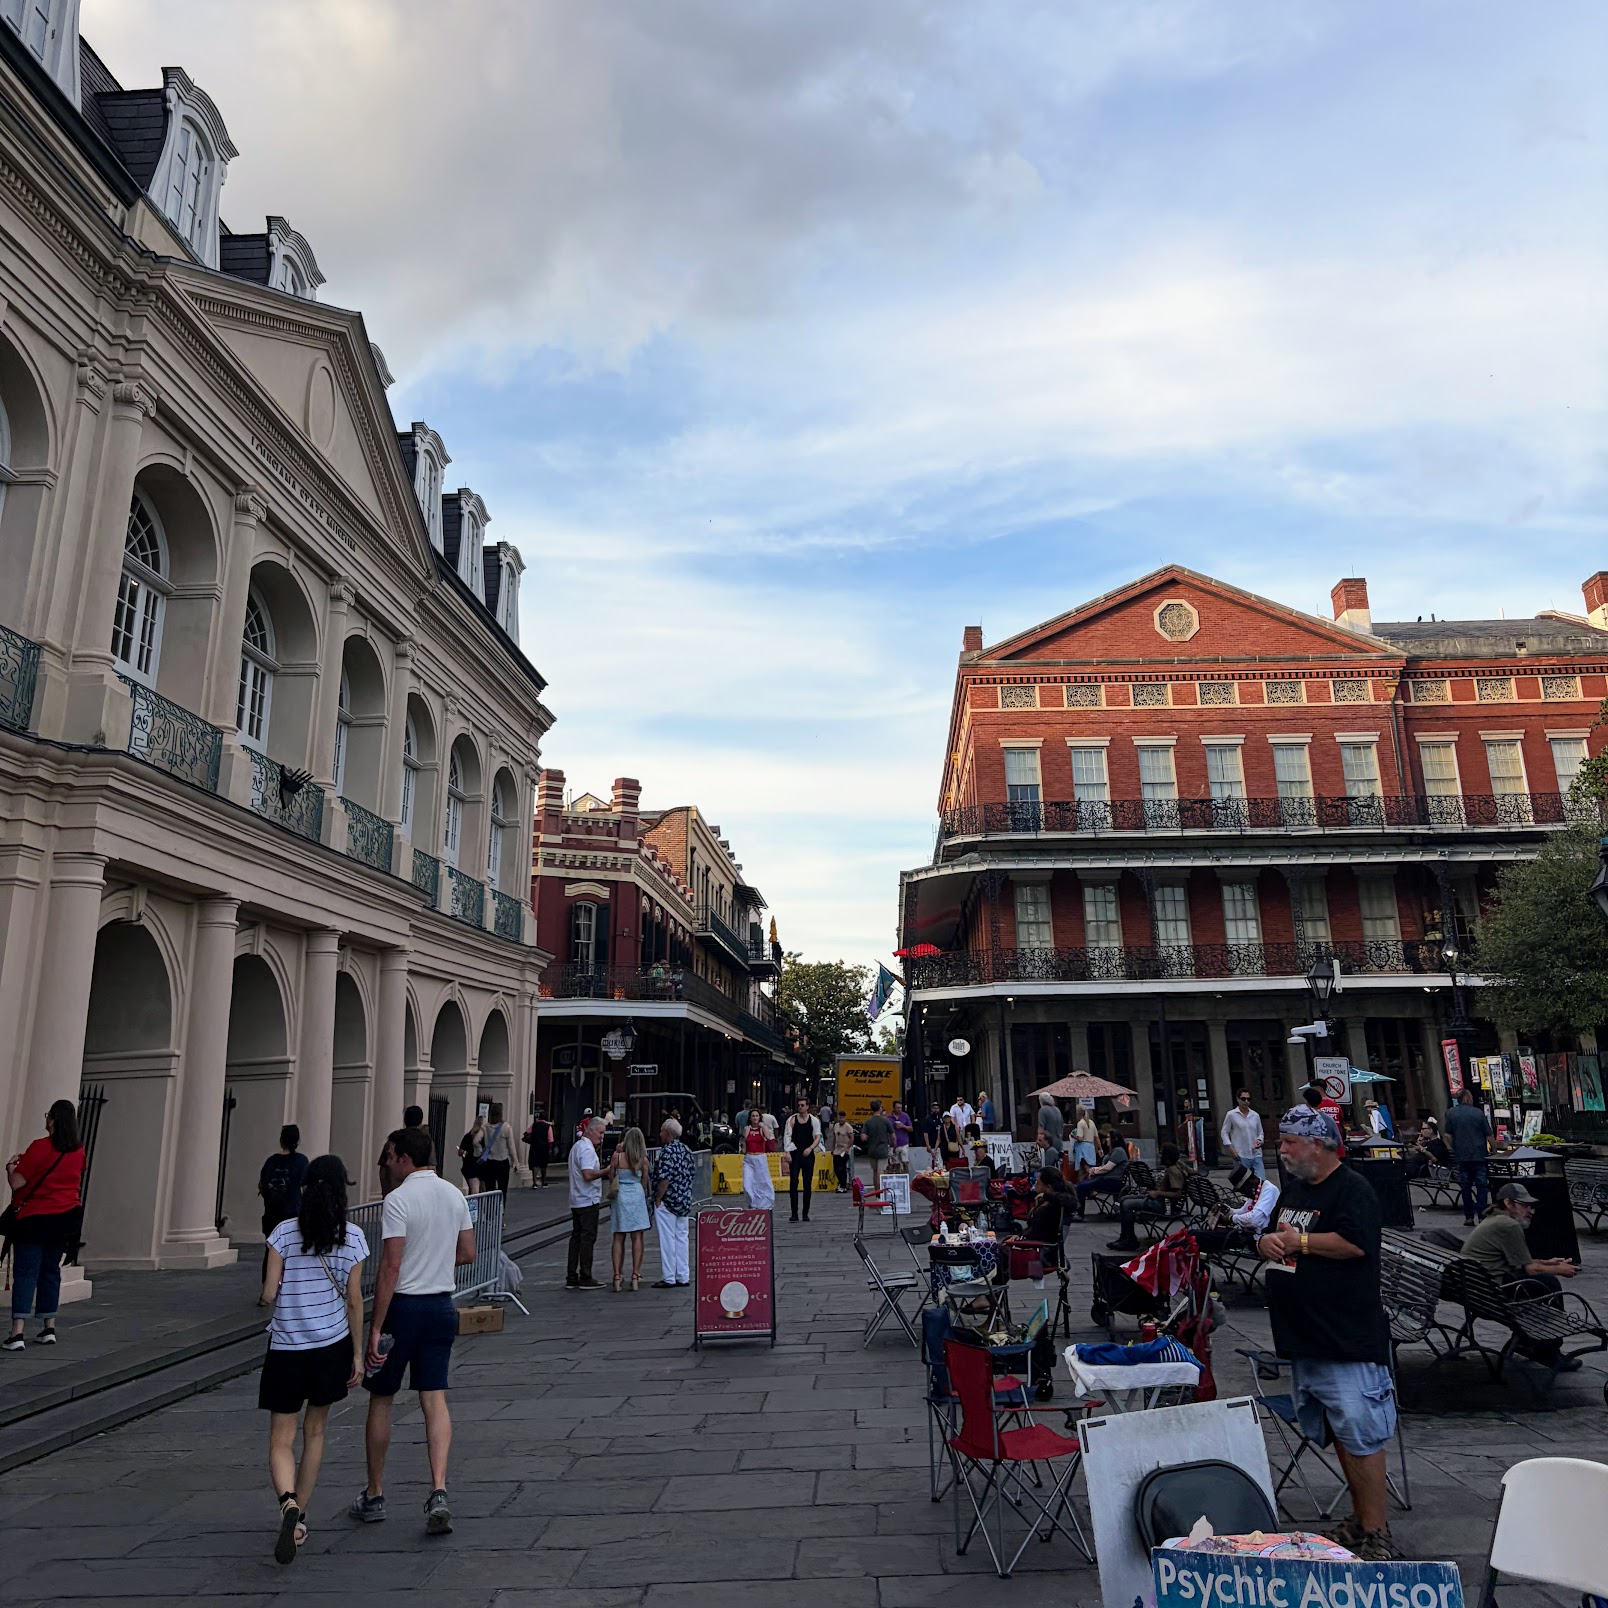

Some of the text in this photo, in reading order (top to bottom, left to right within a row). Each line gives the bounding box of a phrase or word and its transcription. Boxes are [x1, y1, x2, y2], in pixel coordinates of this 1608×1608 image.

[845, 1069, 893, 1078] PENSKE
[700, 1212, 767, 1236] Miss Faith
[1159, 1558, 1455, 1608] Psychic Advisor
